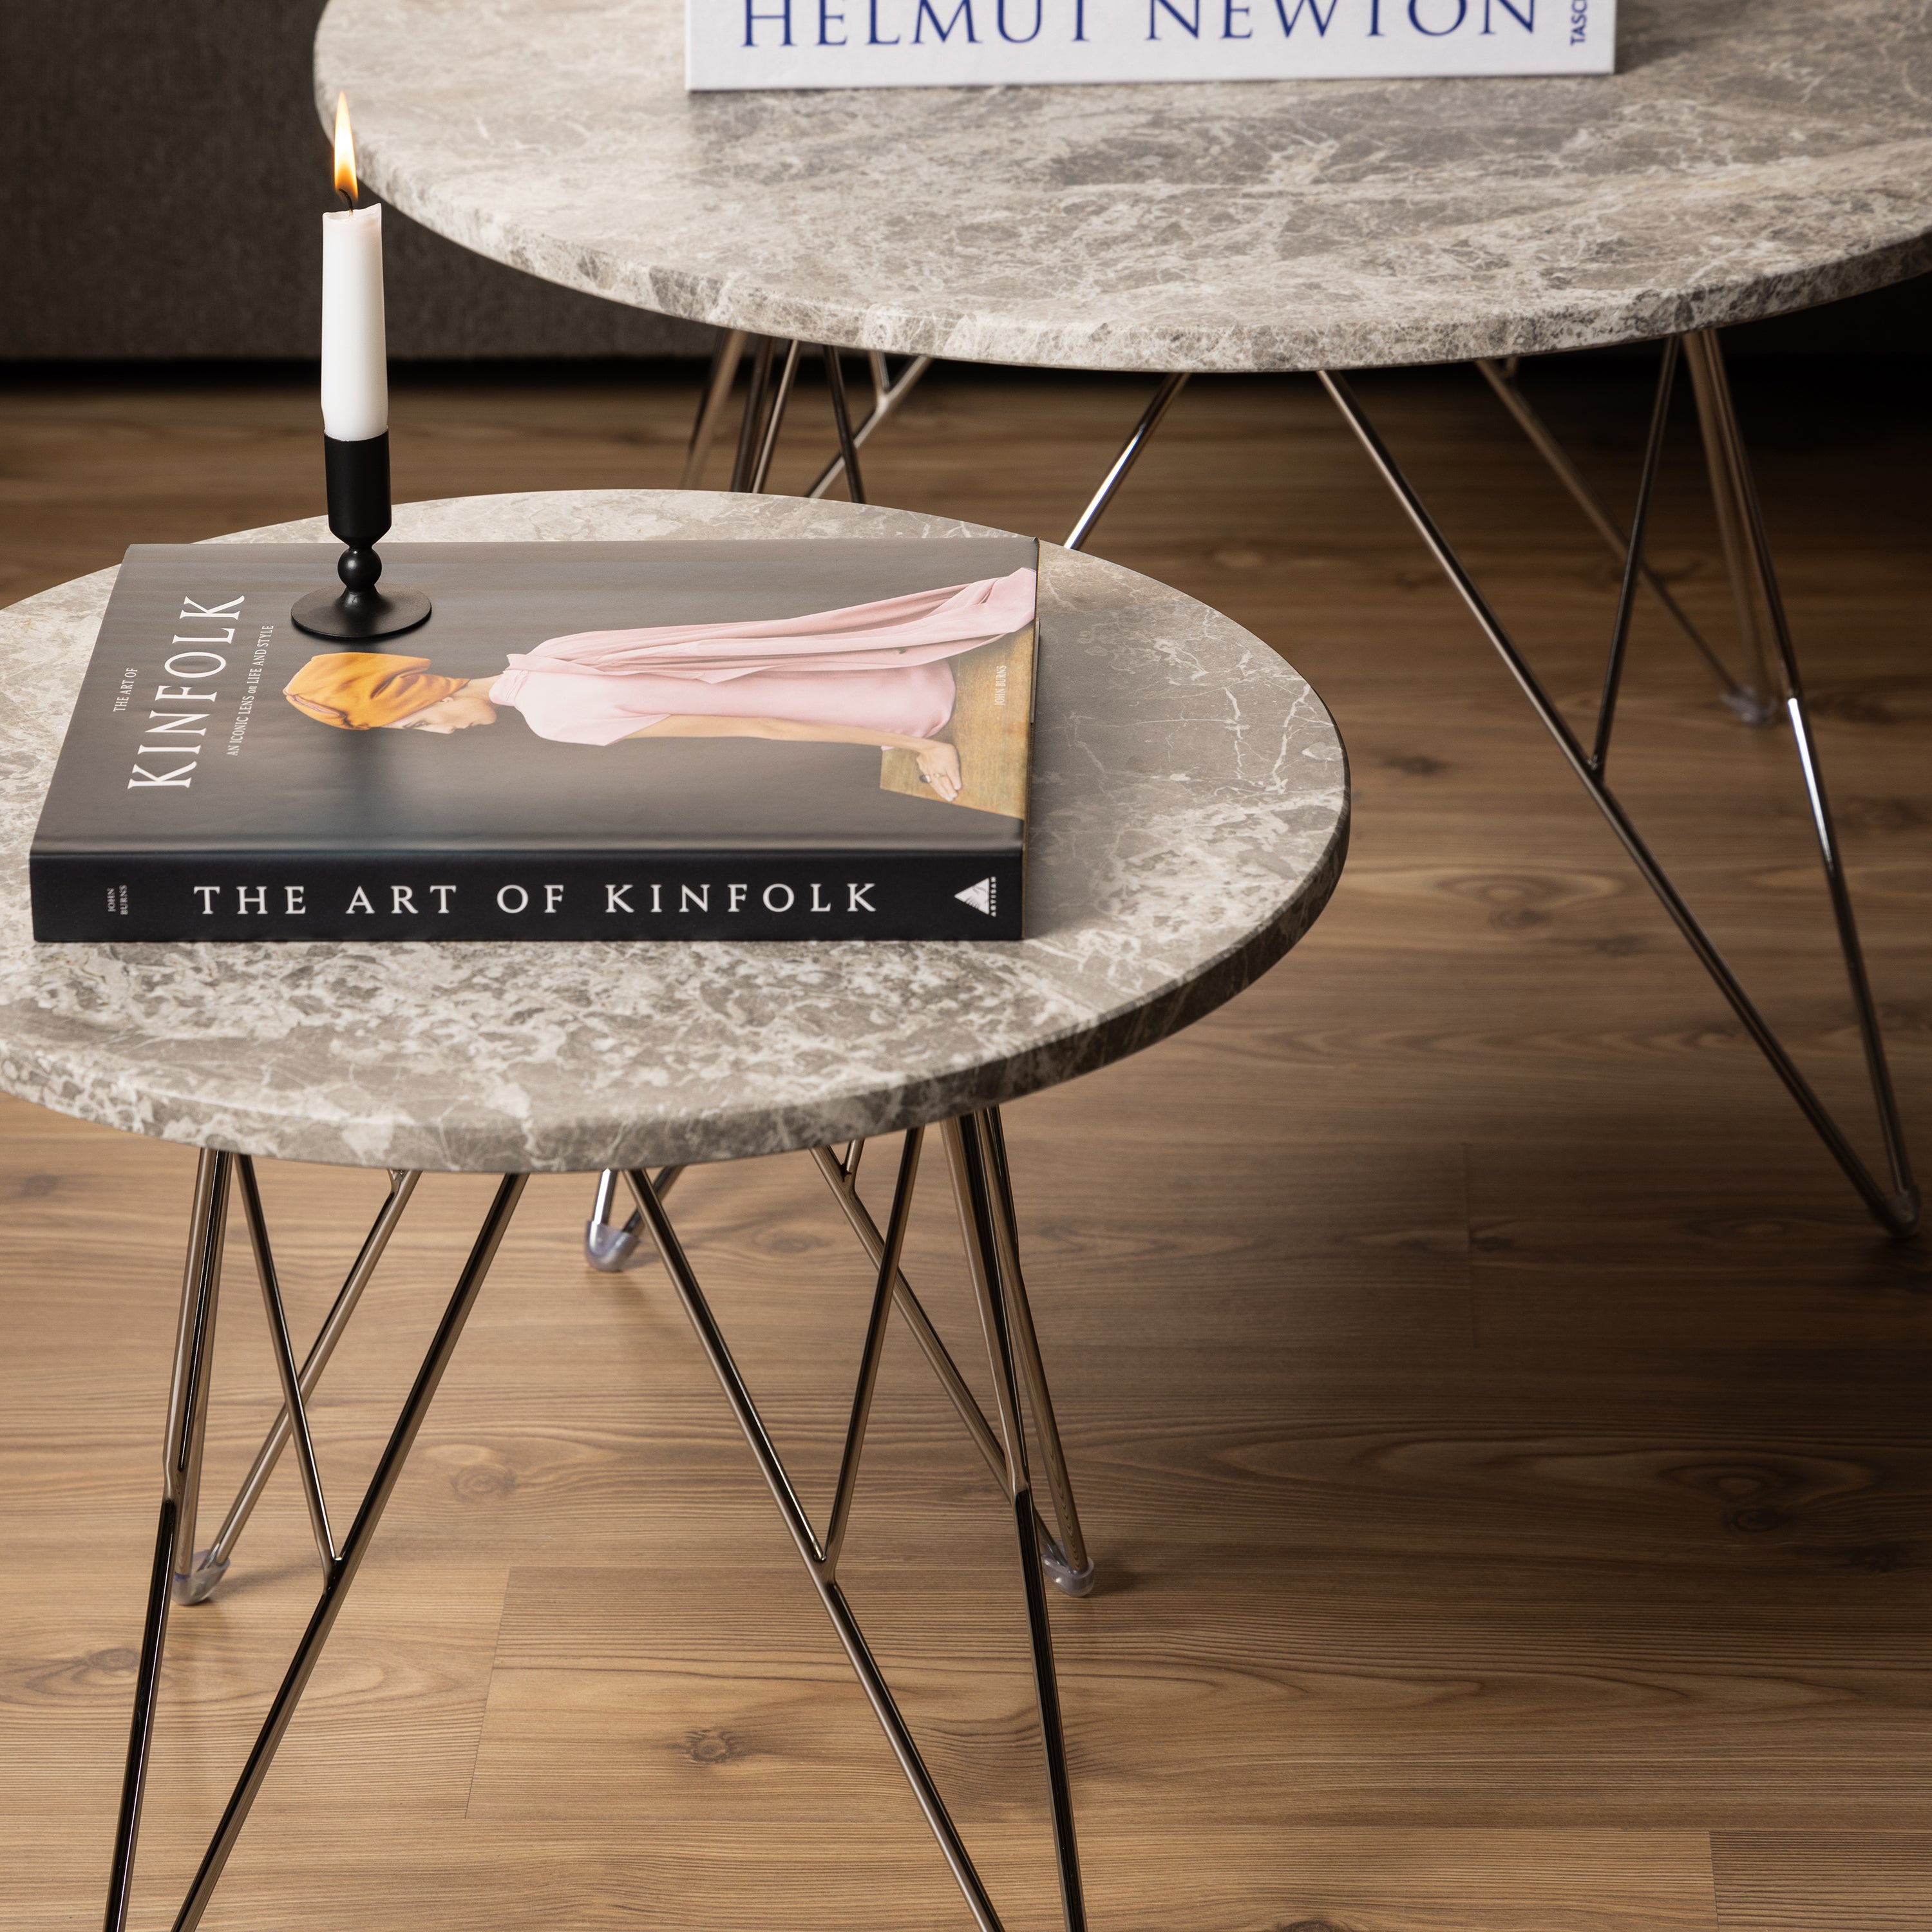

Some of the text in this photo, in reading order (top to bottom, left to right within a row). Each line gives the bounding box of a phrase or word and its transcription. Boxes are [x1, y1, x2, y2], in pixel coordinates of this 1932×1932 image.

[1570, 0, 1587, 46] TASC
[113, 667, 138, 712] THE ART OF
[128, 595, 245, 790] KINFOLK
[227, 625, 274, 756] AN ICONIC LENS on LIFE AND STYLE
[994, 665, 1007, 706] JOHN BURNS
[106, 887, 116, 912] JOHN
[118, 884, 129, 915] BURNS
[194, 883, 876, 914] THE ART OF KINFOLK
